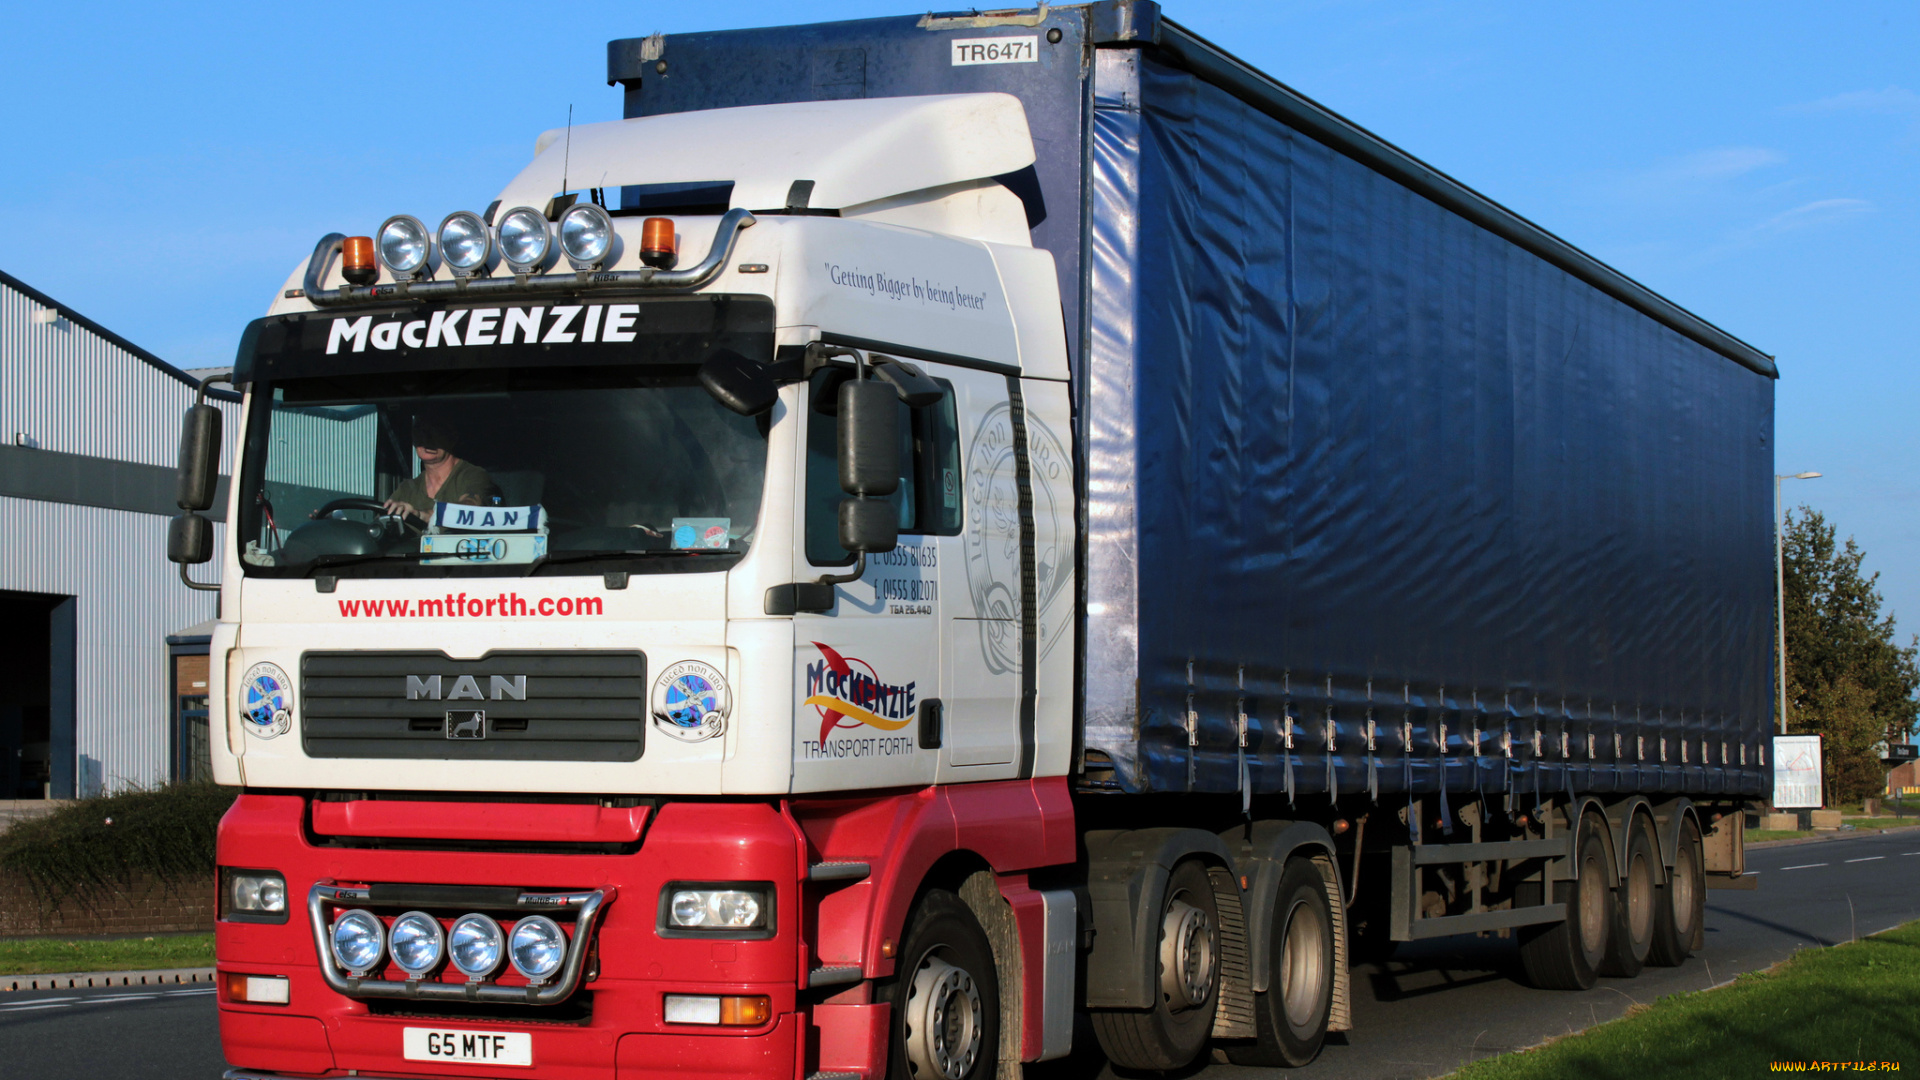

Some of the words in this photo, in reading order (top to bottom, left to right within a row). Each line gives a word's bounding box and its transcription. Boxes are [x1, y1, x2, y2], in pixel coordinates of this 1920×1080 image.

[957, 42, 1032, 62] TR6471
[876, 272, 911, 301] Bigger
[912, 277, 925, 305] by
[926, 280, 955, 310] being
[326, 304, 640, 355] MacKENZIE
[456, 510, 519, 527] MAN
[455, 538, 508, 561] GEO
[910, 545, 937, 568] 811635
[883, 579, 908, 600] 01555
[910, 580, 938, 601] 812071
[338, 592, 604, 618] www.mtforth.com
[889, 604, 905, 615] TGA
[406, 674, 527, 701] MAN
[806, 659, 916, 719] MacKENZIE
[803, 738, 876, 759] TRANSPORT
[878, 737, 913, 756] FORTH
[428, 1032, 455, 1056] G5
[462, 1034, 506, 1058] MTF
